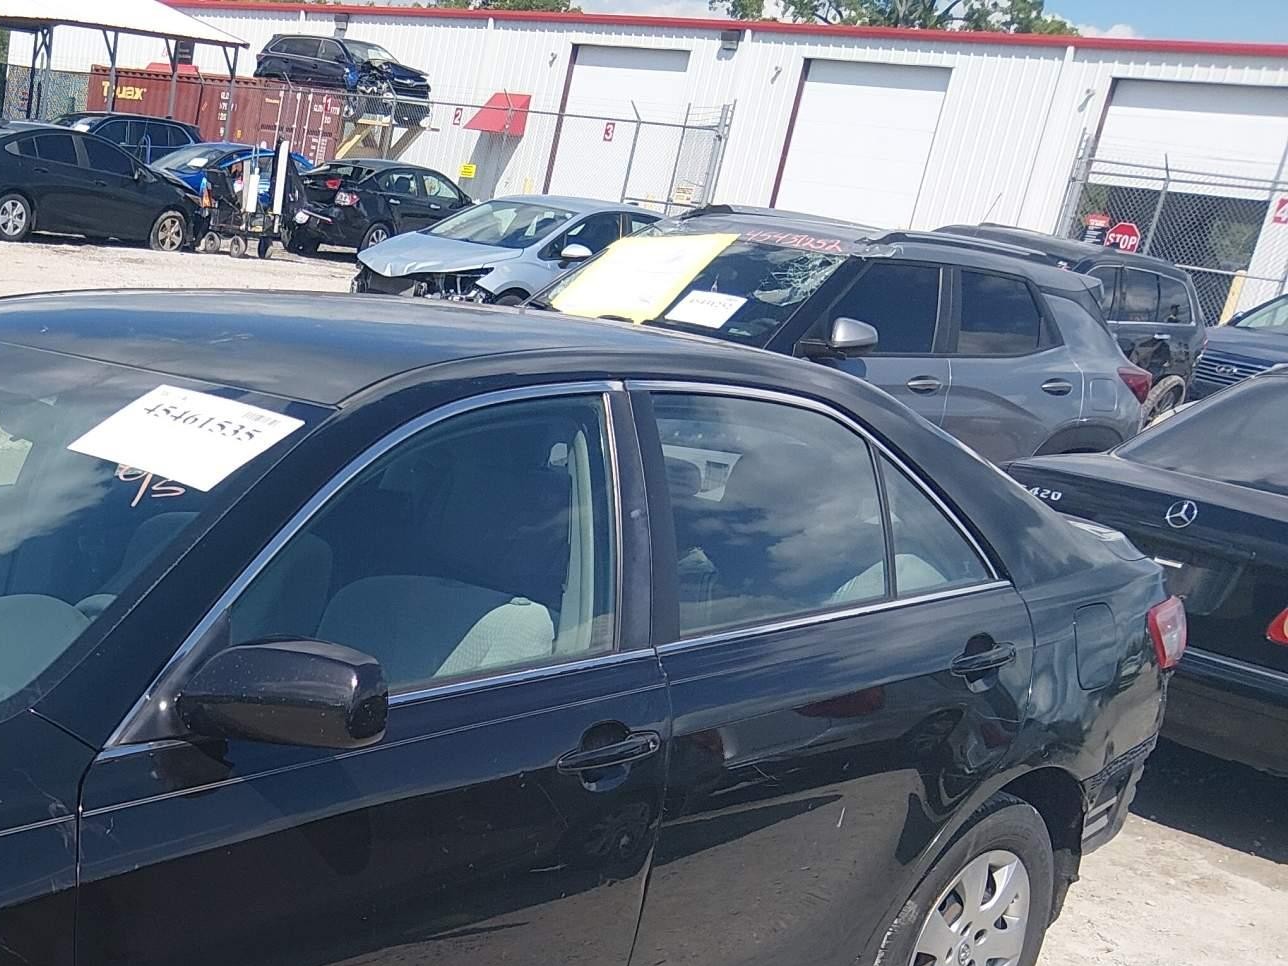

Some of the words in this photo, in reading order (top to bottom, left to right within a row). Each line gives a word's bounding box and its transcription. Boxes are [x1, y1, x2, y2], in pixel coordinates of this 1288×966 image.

[1107, 232, 1137, 250] STOP
[144, 403, 263, 441] 45461535
[1026, 485, 1062, 501] 420
